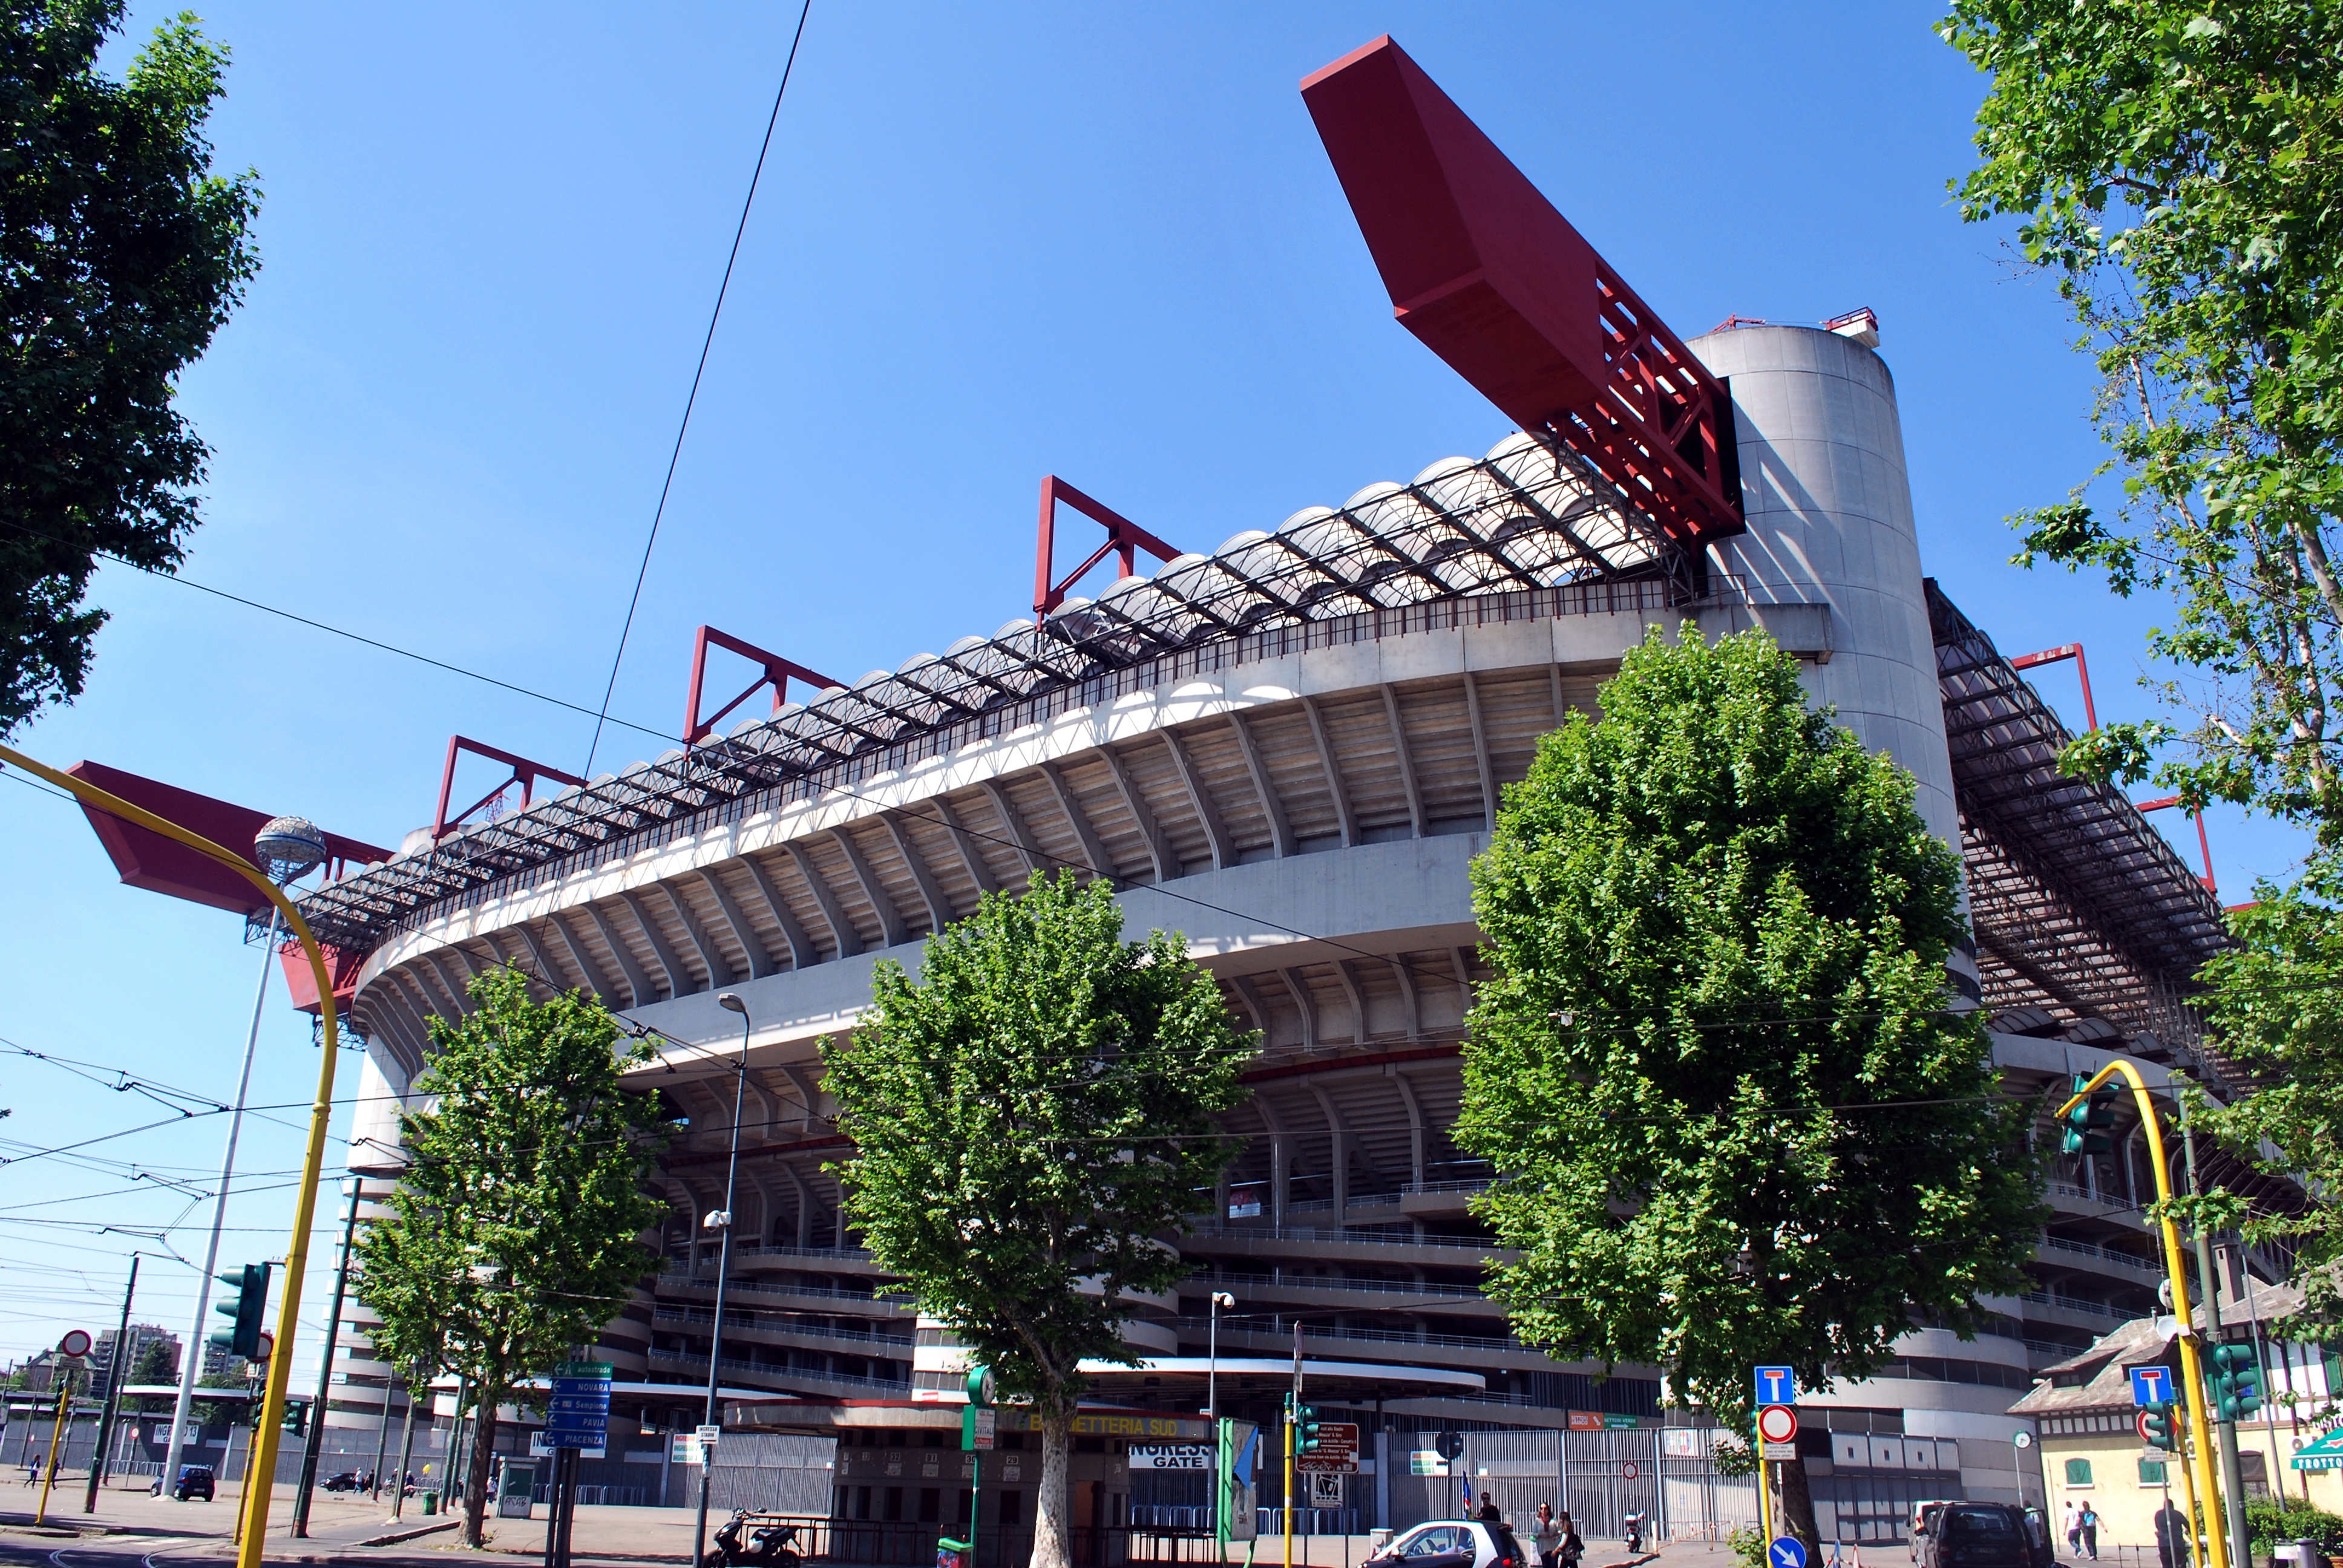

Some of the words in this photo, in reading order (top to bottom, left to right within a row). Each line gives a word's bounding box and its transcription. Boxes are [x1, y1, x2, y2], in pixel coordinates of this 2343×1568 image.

[577, 1383, 608, 1391] NOVARA
[575, 1400, 607, 1410] Sempione
[583, 1418, 605, 1426] PAVIA
[1030, 1414, 1144, 1434] BIETTERIA
[1150, 1419, 1178, 1436] SUD
[189, 1426, 197, 1437] 13
[565, 1435, 603, 1445] PIACENZA
[891, 1452, 900, 1461] 32
[1153, 1457, 1203, 1468] GATE
[2297, 1457, 2342, 1469] TROTTO
